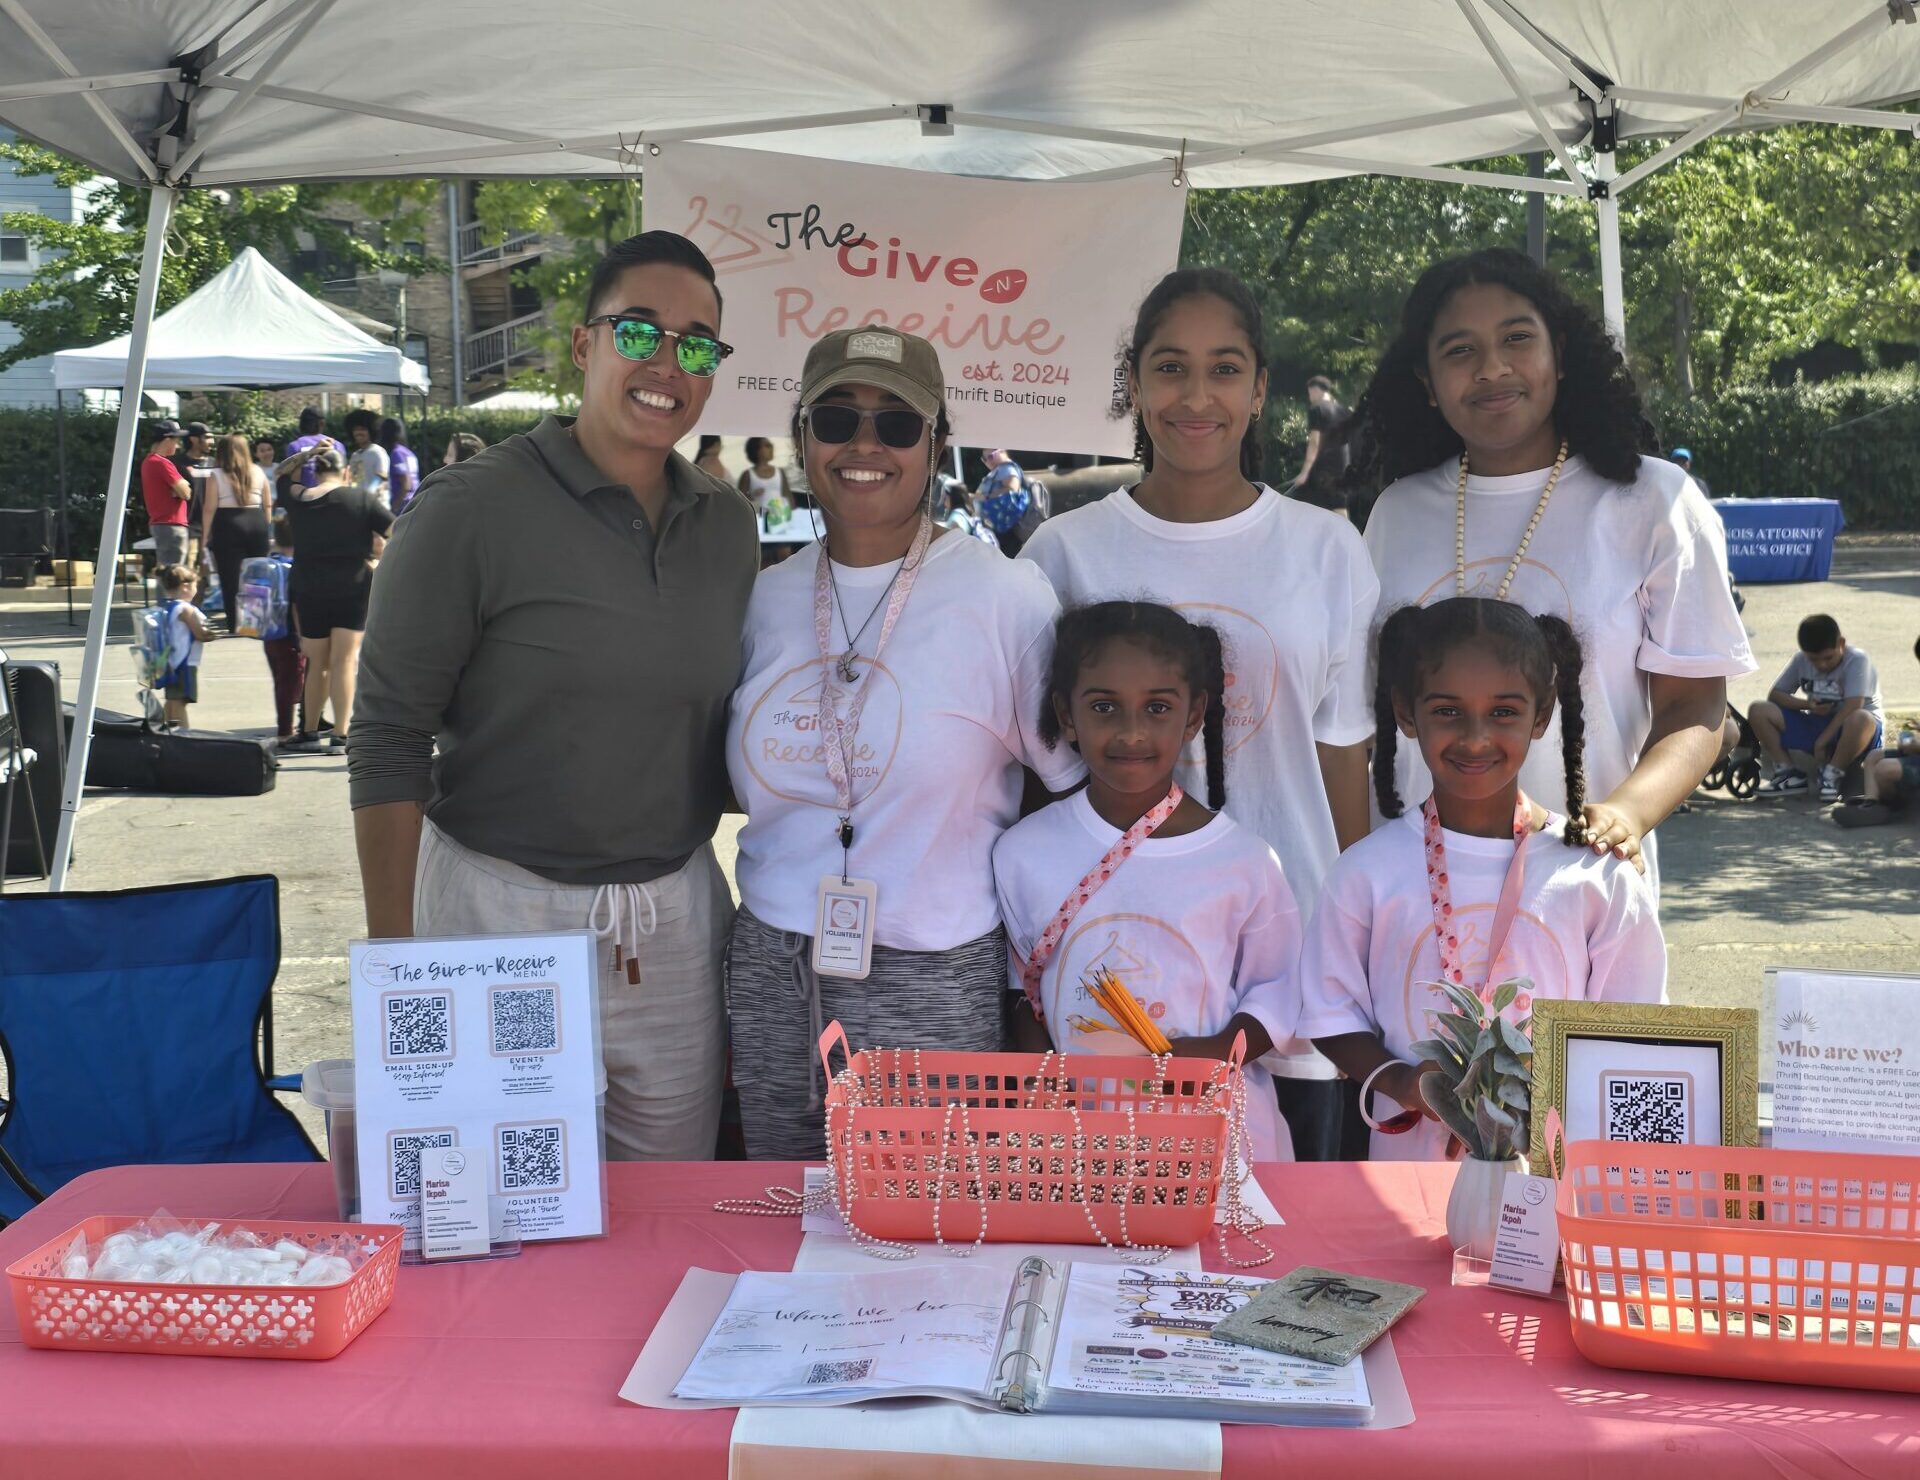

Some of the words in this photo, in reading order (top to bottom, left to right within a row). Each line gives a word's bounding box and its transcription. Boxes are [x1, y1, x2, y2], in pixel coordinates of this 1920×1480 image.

[766, 204, 867, 251] The
[837, 238, 979, 287] Give
[961, 361, 1003, 382] est.
[1012, 363, 1070, 385] 2024
[738, 376, 777, 391] FREE
[945, 386, 989, 402] Thrift
[994, 388, 1066, 408] Boutique
[1756, 527, 1824, 541] ATTORNEY
[1770, 543, 1812, 557] OFFICE
[794, 713, 845, 731] Gie
[763, 737, 876, 764] Recee
[825, 929, 861, 939] VOLUNTEER
[391, 962, 424, 982] The
[514, 970, 547, 979] MENU
[509, 1055, 545, 1064] EVENTS
[1777, 1040, 1820, 1058] Who
[1824, 1045, 1858, 1061] are
[1863, 1047, 1903, 1064] we?
[384, 1063, 414, 1072] EMAIL
[1775, 1060, 1791, 1069] The
[1882, 1067, 1904, 1076] FREE
[1842, 1075, 1874, 1086] offering
[1876, 1079, 1901, 1088] gently
[1775, 1083, 1820, 1093] accessories
[1821, 1085, 1832, 1093] for
[1834, 1086, 1876, 1097] individuals
[1877, 1089, 1886, 1097] of
[1887, 1090, 1903, 1099] ALL
[1791, 1095, 1821, 1104] pop-up
[1822, 1097, 1849, 1105] events
[1874, 1101, 1903, 1110] around
[1775, 1104, 1800, 1112] where
[1814, 1107, 1858, 1117] collaborate
[1860, 1109, 1878, 1118] with
[1879, 1111, 1899, 1119] local
[1774, 1115, 1790, 1123] and
[1818, 1119, 1844, 1127] spaces
[1856, 1121, 1887, 1130] provide
[1774, 1126, 1796, 1134] those
[1797, 1127, 1827, 1138] looking
[1839, 1131, 1867, 1139] receive
[1893, 1134, 1904, 1142] for
[426, 1180, 450, 1189] Marisa
[1503, 1203, 1527, 1216] Marisa
[1501, 1213, 1522, 1226] Ikpoh
